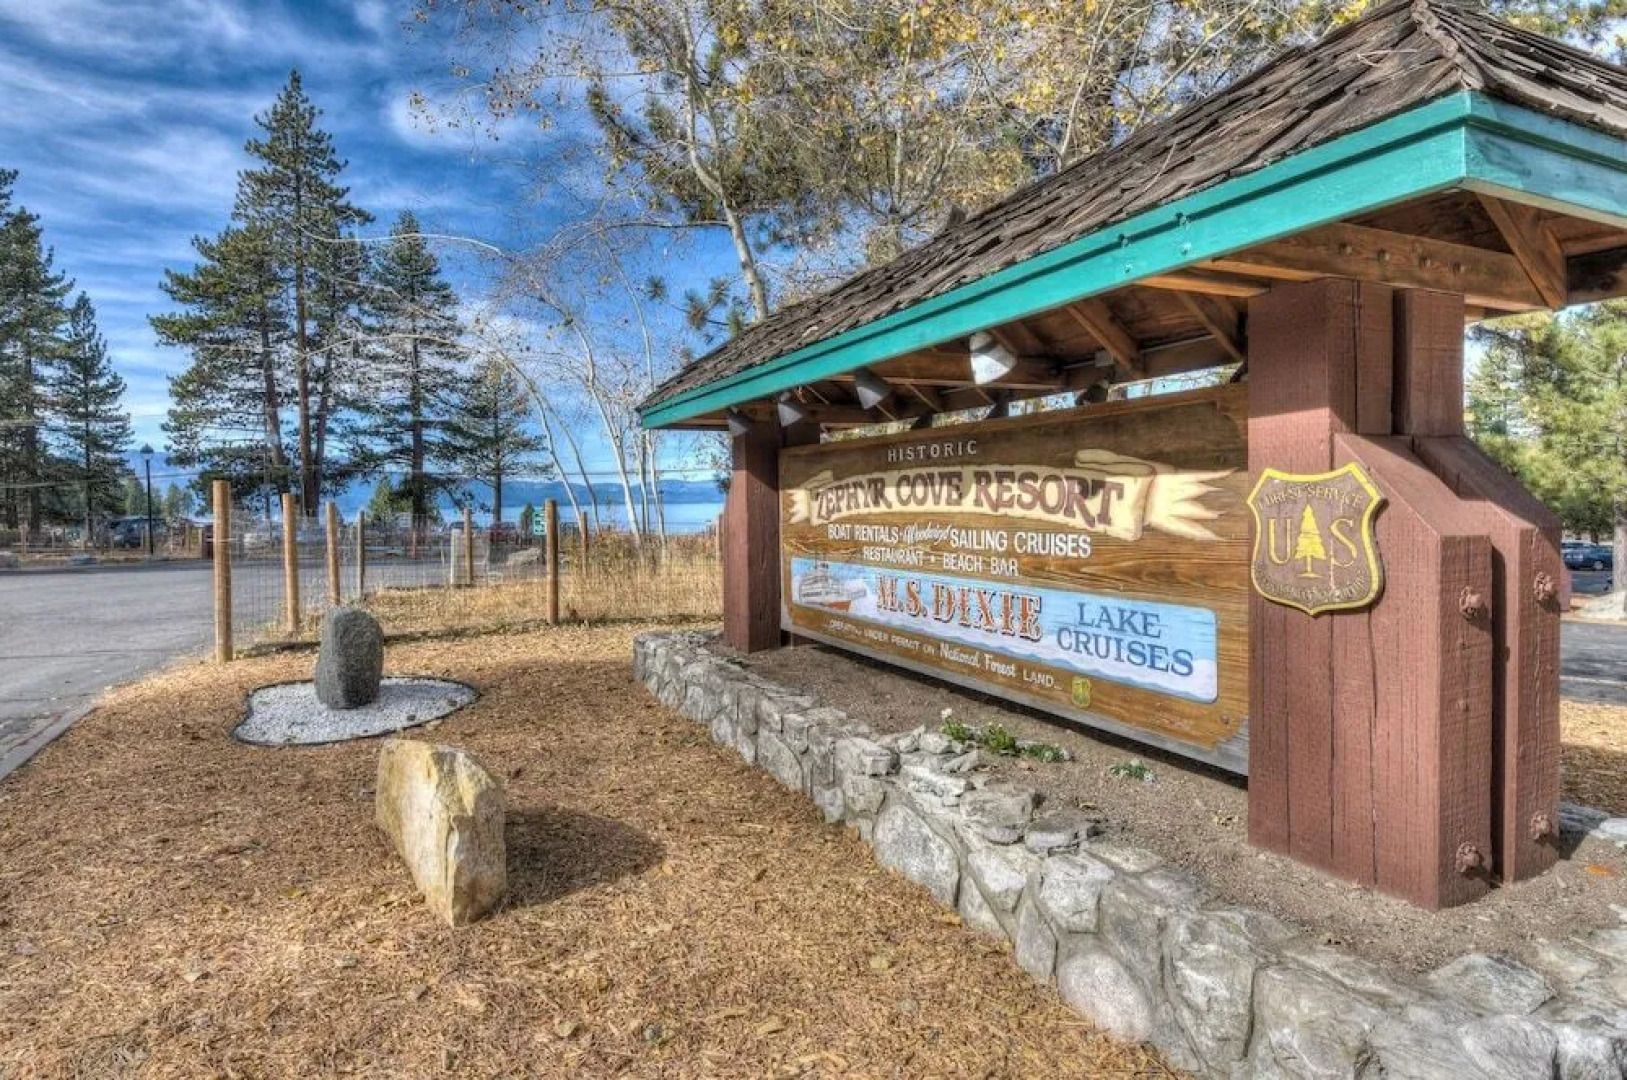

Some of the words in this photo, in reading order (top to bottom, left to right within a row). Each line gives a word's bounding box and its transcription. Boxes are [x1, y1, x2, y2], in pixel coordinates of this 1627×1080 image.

[887, 440, 978, 463] HISTORIC
[816, 476, 893, 520] ZEPHYR
[896, 471, 964, 507] COVE
[973, 469, 1125, 528] RESORT
[827, 523, 851, 541] BOAT
[854, 524, 899, 543] RENTALS
[949, 528, 1008, 552] SAILING
[1014, 530, 1092, 559] CRUISES
[862, 545, 925, 567] RESTAURANT
[943, 552, 982, 573] BEACH
[990, 555, 1019, 577] BAR
[1268, 517, 1293, 566] U
[1329, 517, 1359, 568] S
[931, 582, 1044, 643] DIXIE
[1077, 601, 1163, 639] LAKE
[939, 641, 982, 669] National
[983, 651, 1016, 678] Forest
[1022, 668, 1056, 688] LAND
[1056, 626, 1194, 677] CRUISES
